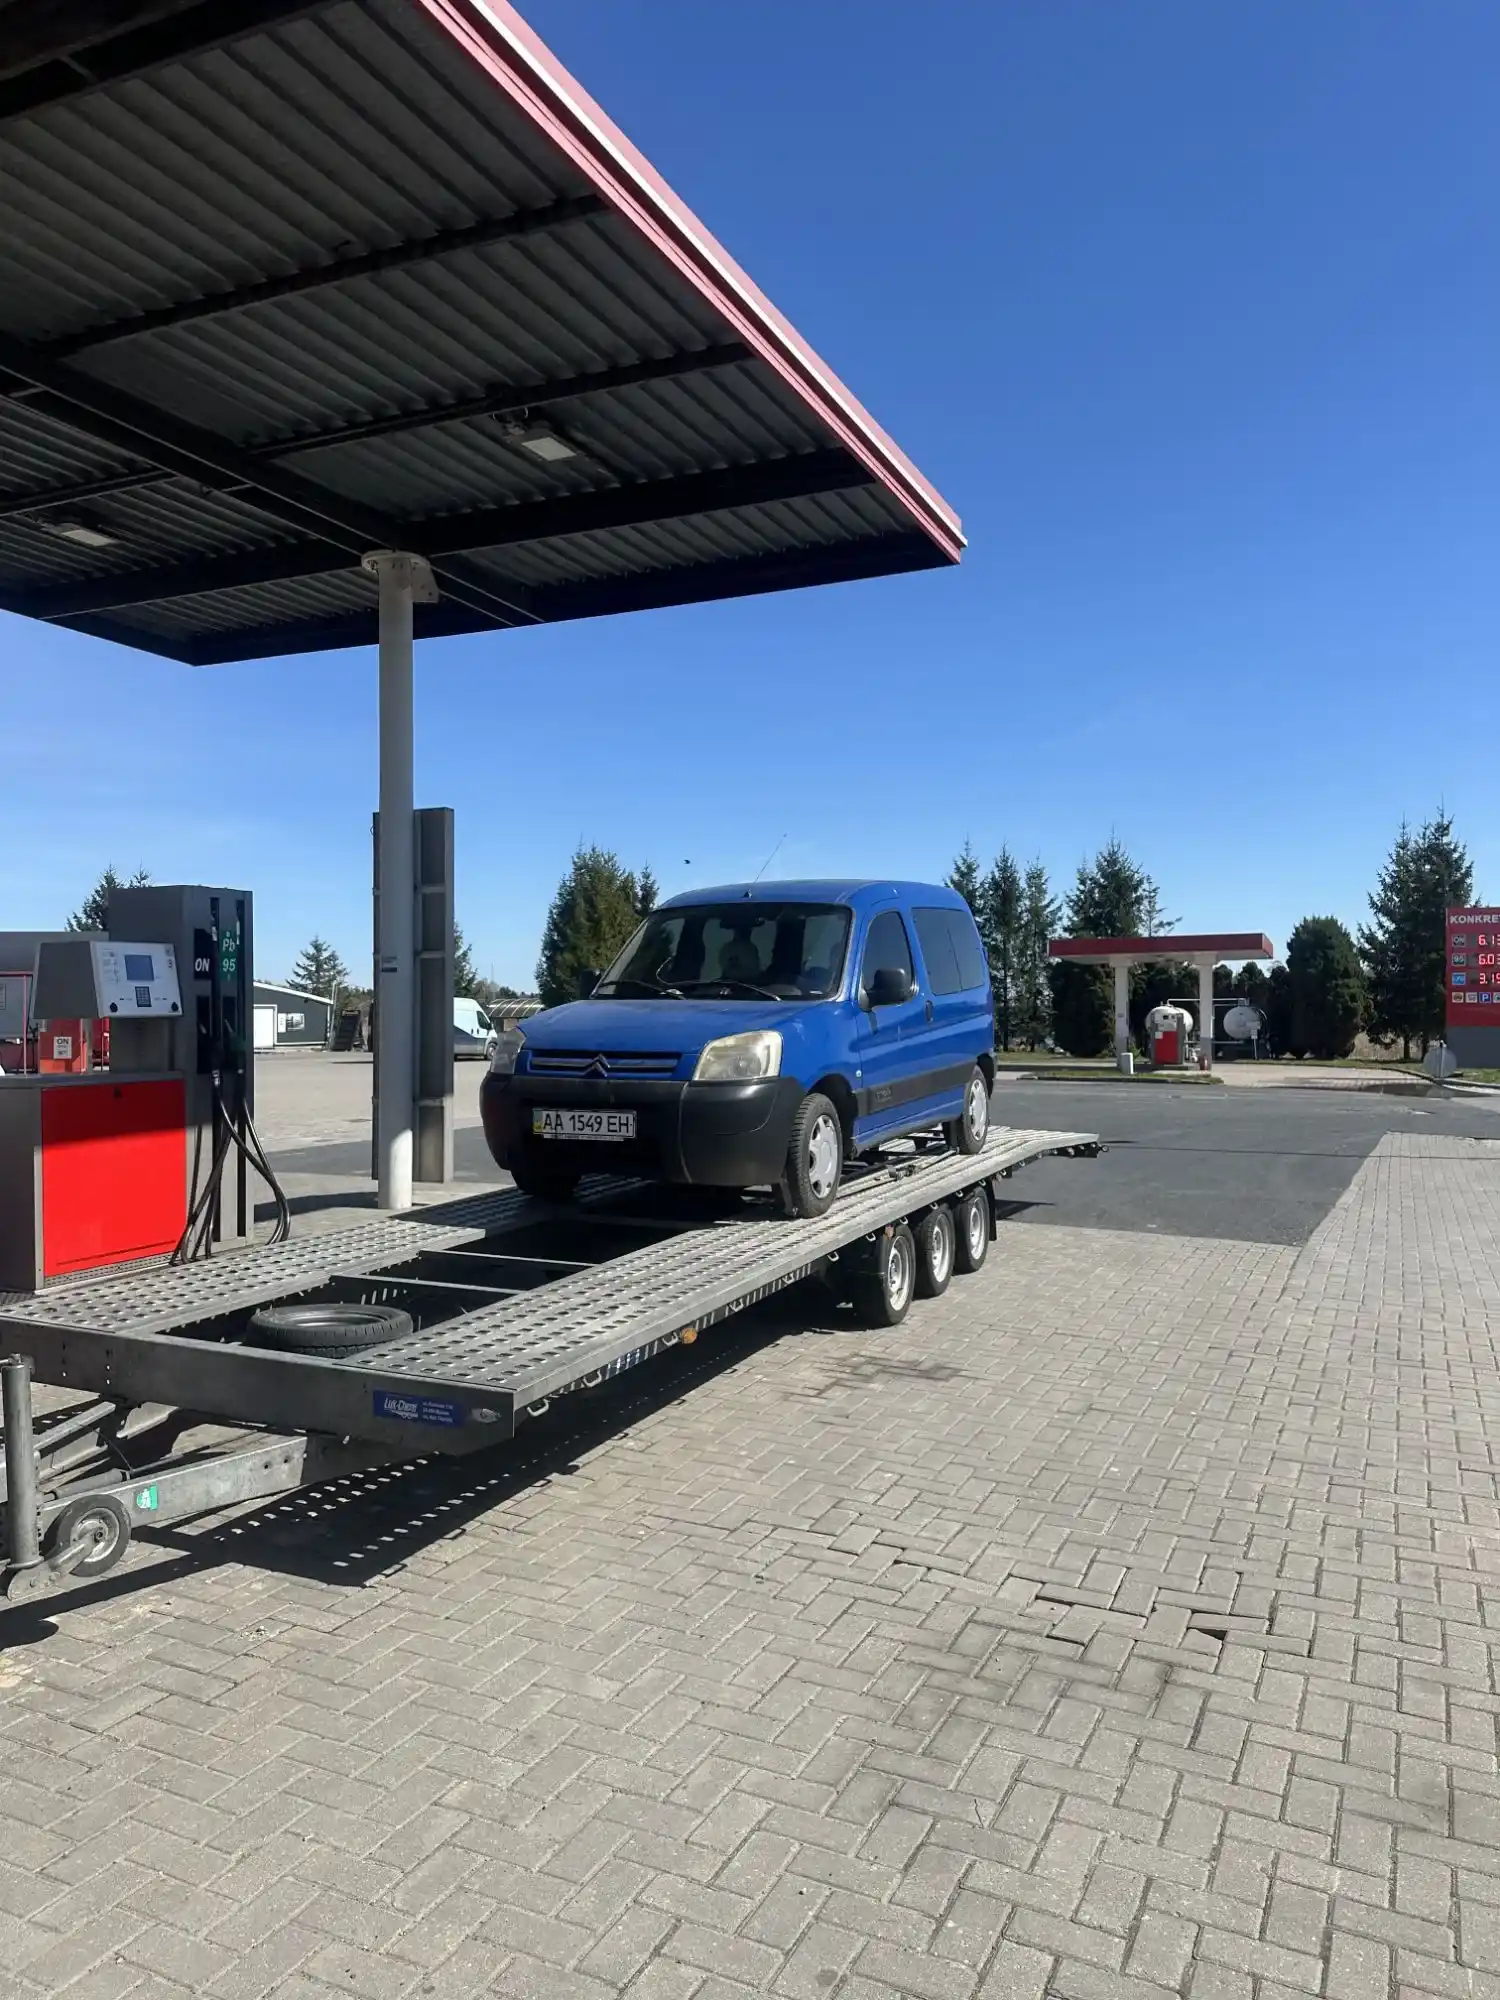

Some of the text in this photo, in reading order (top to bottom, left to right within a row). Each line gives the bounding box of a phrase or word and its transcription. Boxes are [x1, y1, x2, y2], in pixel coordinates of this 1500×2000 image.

[1449, 915, 1500, 924] KONKRE
[222, 938, 236, 952] Pb
[195, 957, 210, 972] ON
[222, 958, 236, 972] 95
[543, 1113, 629, 1134] AA 1549 EH
